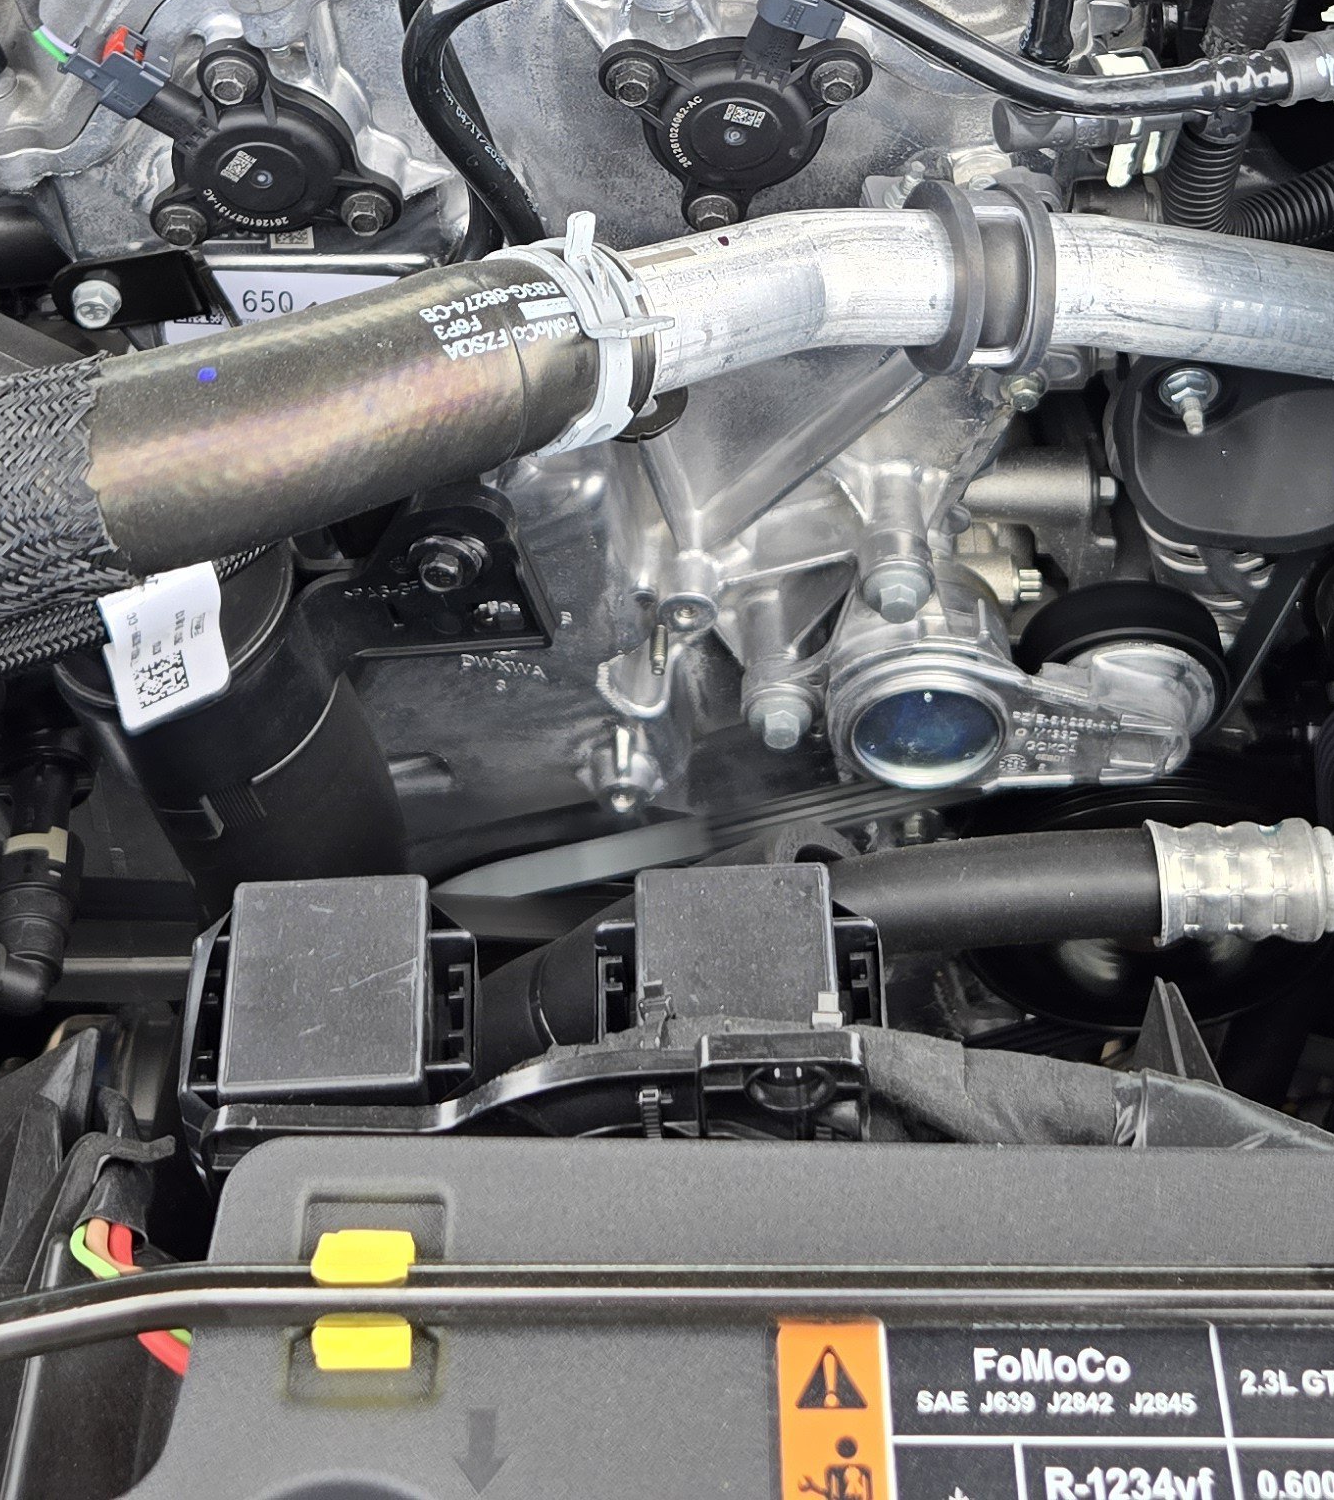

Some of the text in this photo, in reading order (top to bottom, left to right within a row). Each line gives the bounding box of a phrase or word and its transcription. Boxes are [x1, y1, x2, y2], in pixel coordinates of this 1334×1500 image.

[242, 289, 294, 314] 650
[419, 281, 561, 324] RB3G-8B274-CB
[433, 314, 483, 341] F6P3
[512, 316, 580, 344] FoMoCo
[973, 1347, 1131, 1383] FoMoCo
[1239, 1369, 1299, 1396] 2.3L
[917, 1390, 1199, 1415] SAE J639 J2842 J2845
